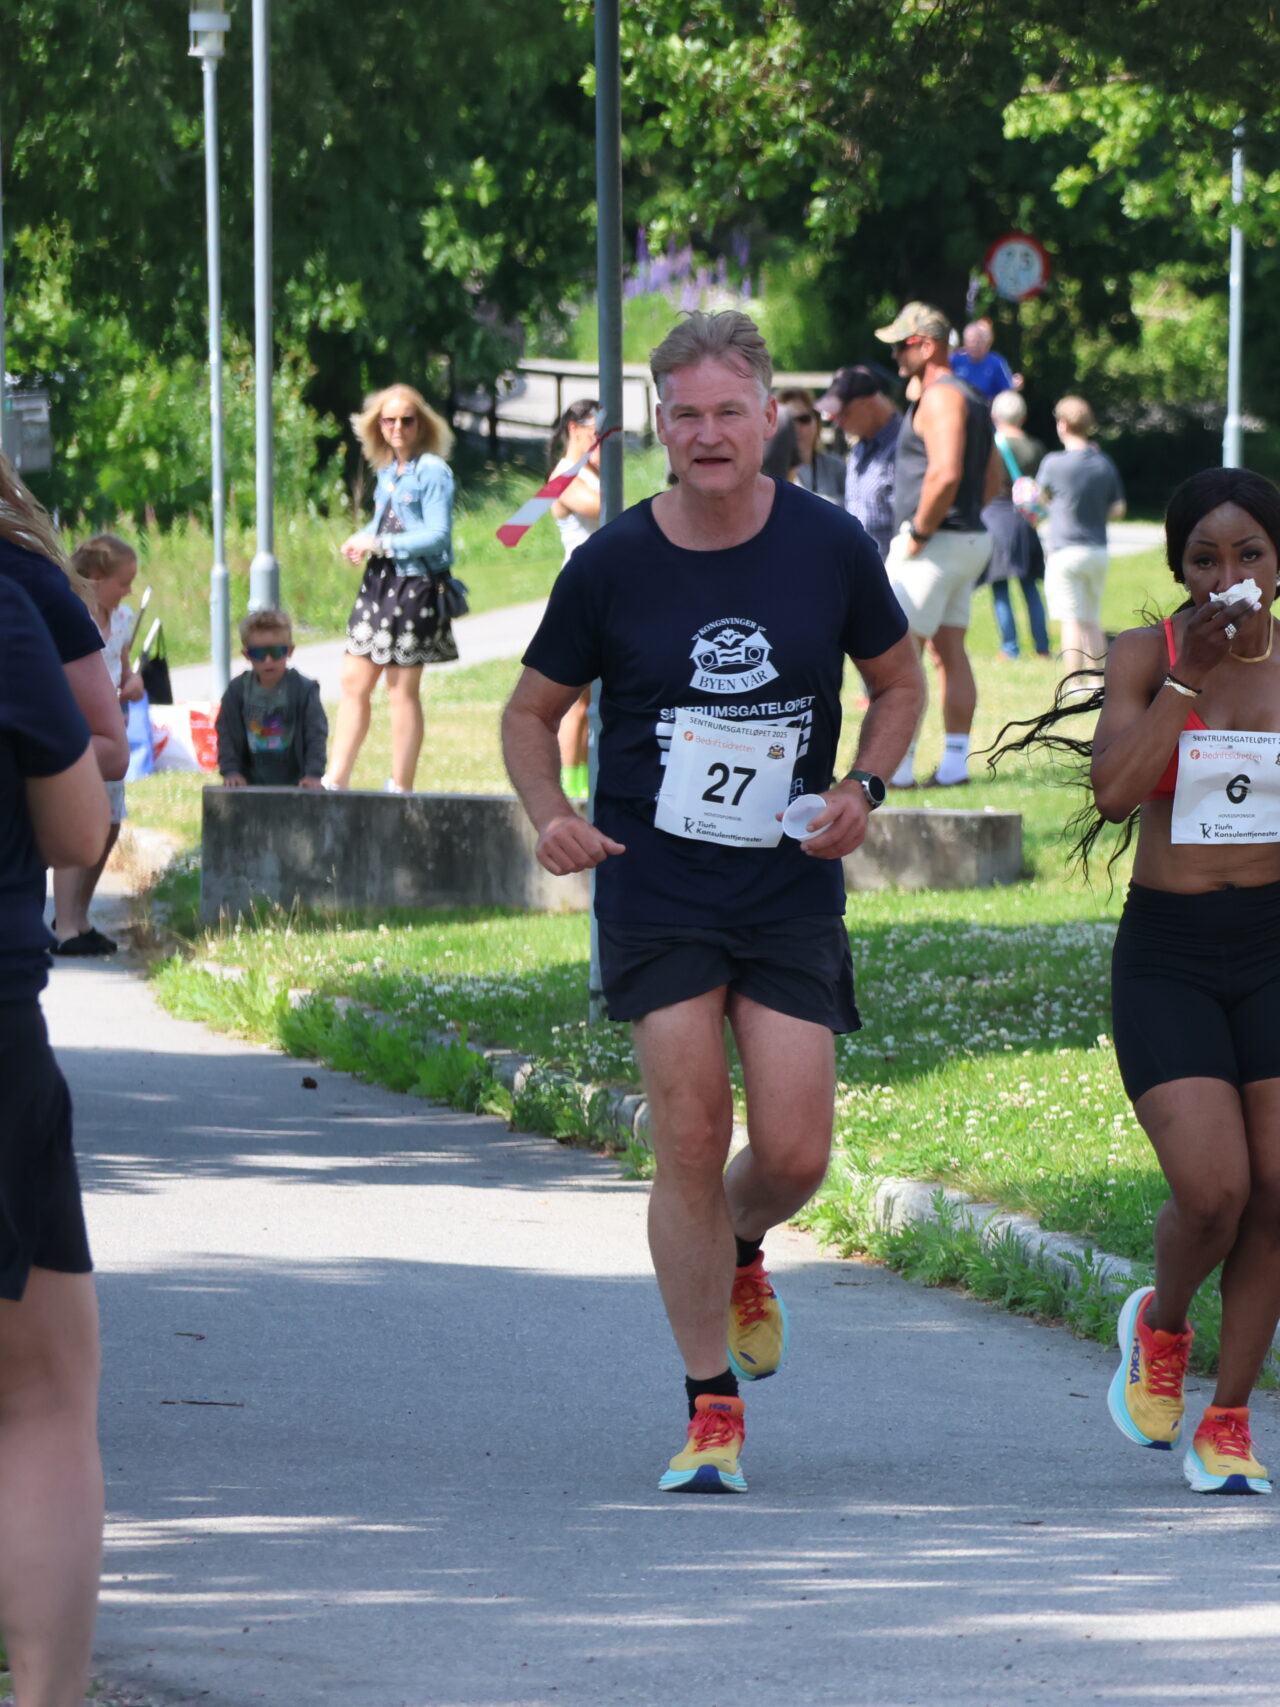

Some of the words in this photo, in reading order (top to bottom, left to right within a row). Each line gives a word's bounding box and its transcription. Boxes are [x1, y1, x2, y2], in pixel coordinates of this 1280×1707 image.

[698, 617, 758, 636] KONGSVINGER
[700, 675, 736, 691] BYEN
[689, 716, 771, 738] SENTRUMSGATELØPET
[1192, 735, 1276, 745] SENTRUMSGATELØPET
[701, 762, 757, 806] 27
[1226, 773, 1251, 804] 6
[1214, 830, 1278, 839] Konsulenttjenester
[1129, 1337, 1140, 1384] HOKA
